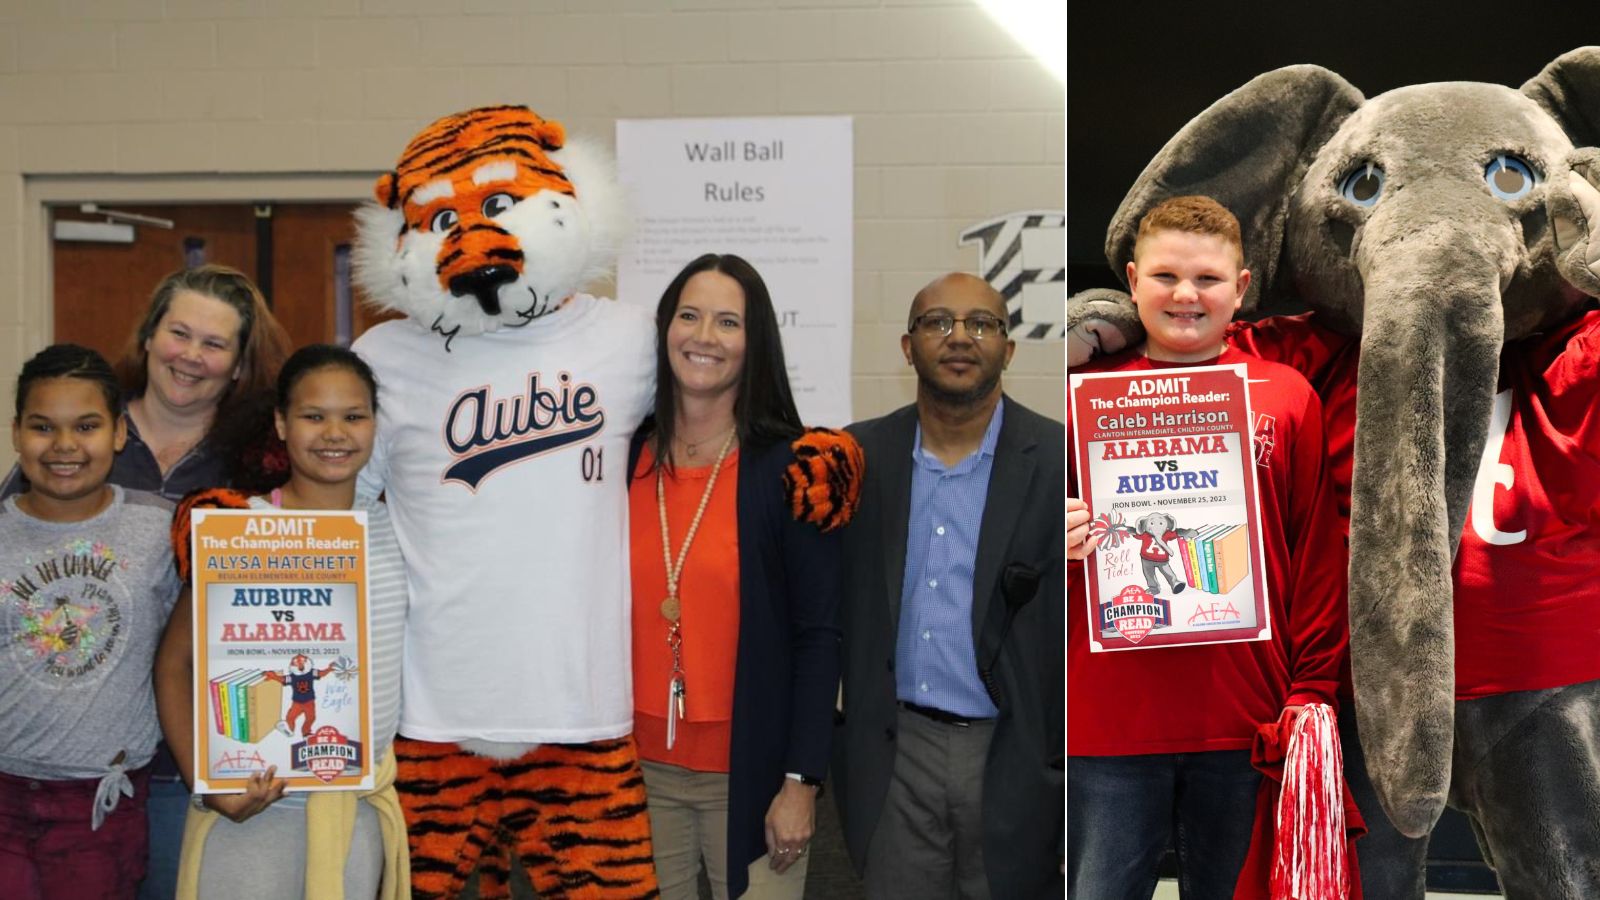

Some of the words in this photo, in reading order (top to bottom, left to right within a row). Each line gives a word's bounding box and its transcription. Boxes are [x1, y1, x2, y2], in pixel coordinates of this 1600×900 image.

[685, 140, 735, 162] Wall
[743, 140, 784, 162] Ball
[704, 181, 765, 202] Rules
[1127, 377, 1191, 396] ADMIT
[1090, 398, 1113, 410] The
[1116, 394, 1180, 408] Champion
[1183, 391, 1230, 404] Reader:
[1097, 412, 1147, 430] Caleb
[1152, 410, 1229, 427] Harrison
[1093, 431, 1125, 439] CLANTON
[1177, 426, 1205, 434] CHILTON
[1206, 424, 1234, 432] COUNTY
[1101, 435, 1229, 461] ALABAMA
[582, 447, 604, 482] 01
[1116, 470, 1218, 494] AUBURN
[1131, 500, 1152, 508] BOWL
[1157, 497, 1197, 506] NOVEMBER
[1210, 495, 1227, 503] 2023
[245, 518, 316, 536] ADMIT
[201, 536, 228, 549] The
[230, 536, 303, 551] Champion
[306, 536, 360, 549] Reader:
[207, 555, 262, 570] ALYSA
[267, 555, 357, 570] HATCHETT
[1105, 548, 1131, 566] Roll
[62, 553, 116, 582] CHANGE
[1103, 564, 1135, 580] Tide!
[231, 588, 333, 606] AUBURN
[1106, 604, 1161, 621] CHAMPION
[1187, 601, 1241, 625] AEA
[220, 623, 346, 643] ALABAMA
[1118, 618, 1153, 631] READ
[227, 648, 244, 656] IRON
[246, 648, 268, 656] BOWL
[271, 648, 310, 656] NOVEMBER
[300, 745, 353, 760] CHAMPION
[312, 758, 345, 771] READ
